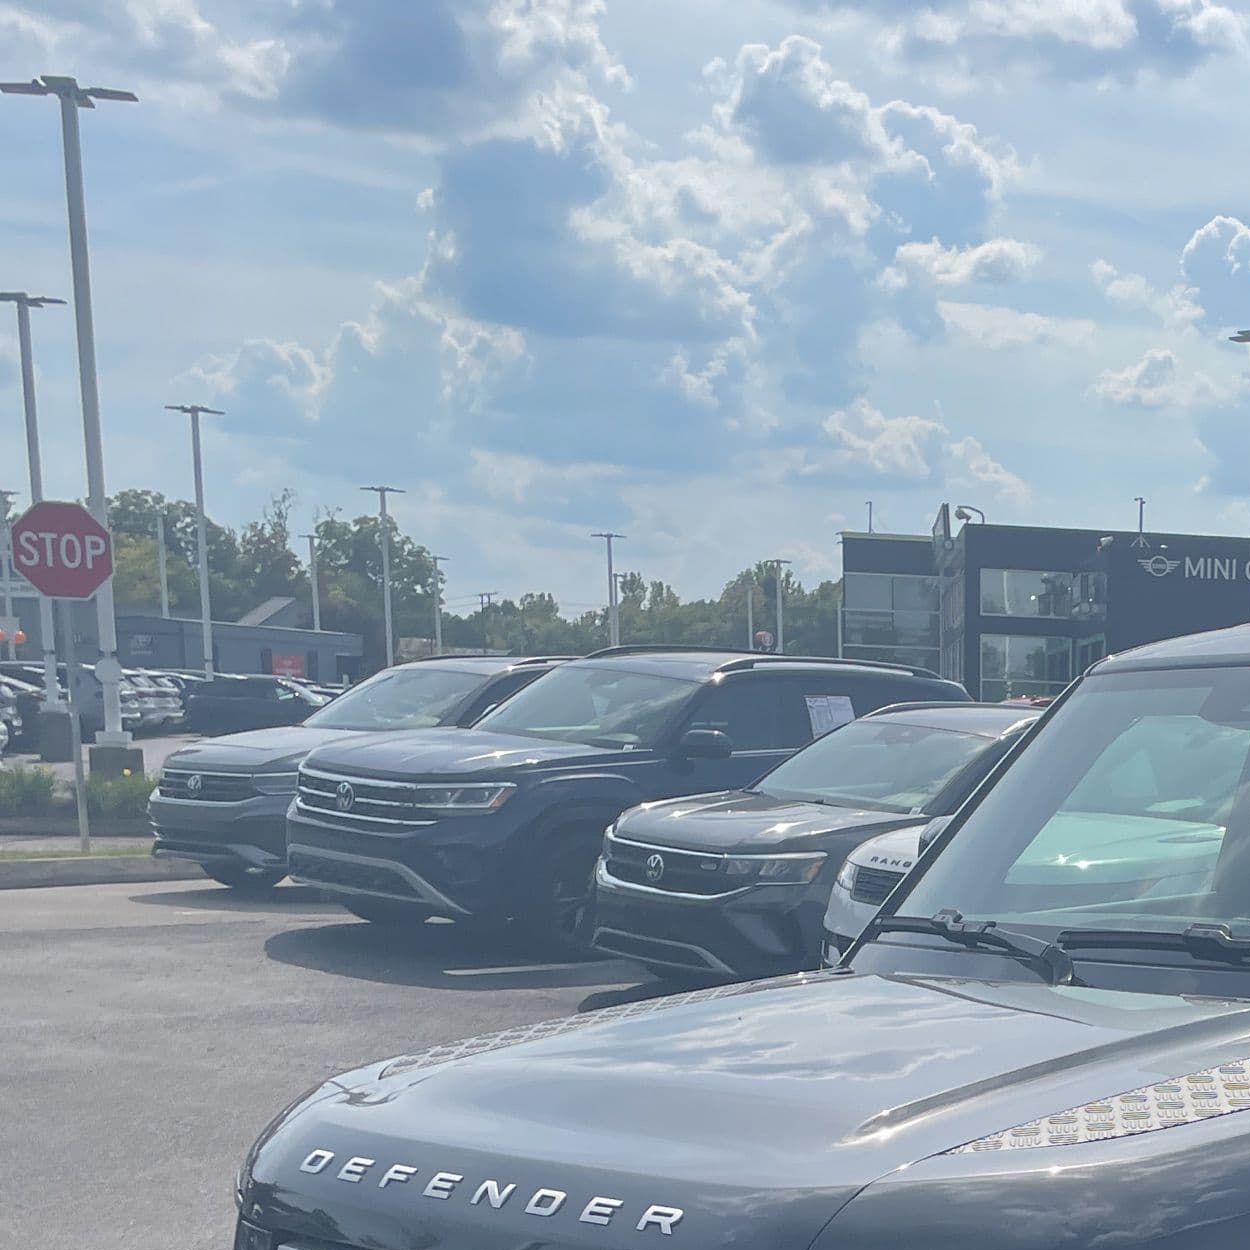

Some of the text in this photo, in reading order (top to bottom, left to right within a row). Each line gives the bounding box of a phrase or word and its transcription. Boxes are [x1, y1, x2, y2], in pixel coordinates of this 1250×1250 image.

[19, 530, 106, 569] STOP
[1184, 556, 1236, 580] MINI
[870, 856, 913, 868] RANG
[299, 1148, 684, 1235] DEFENDER
